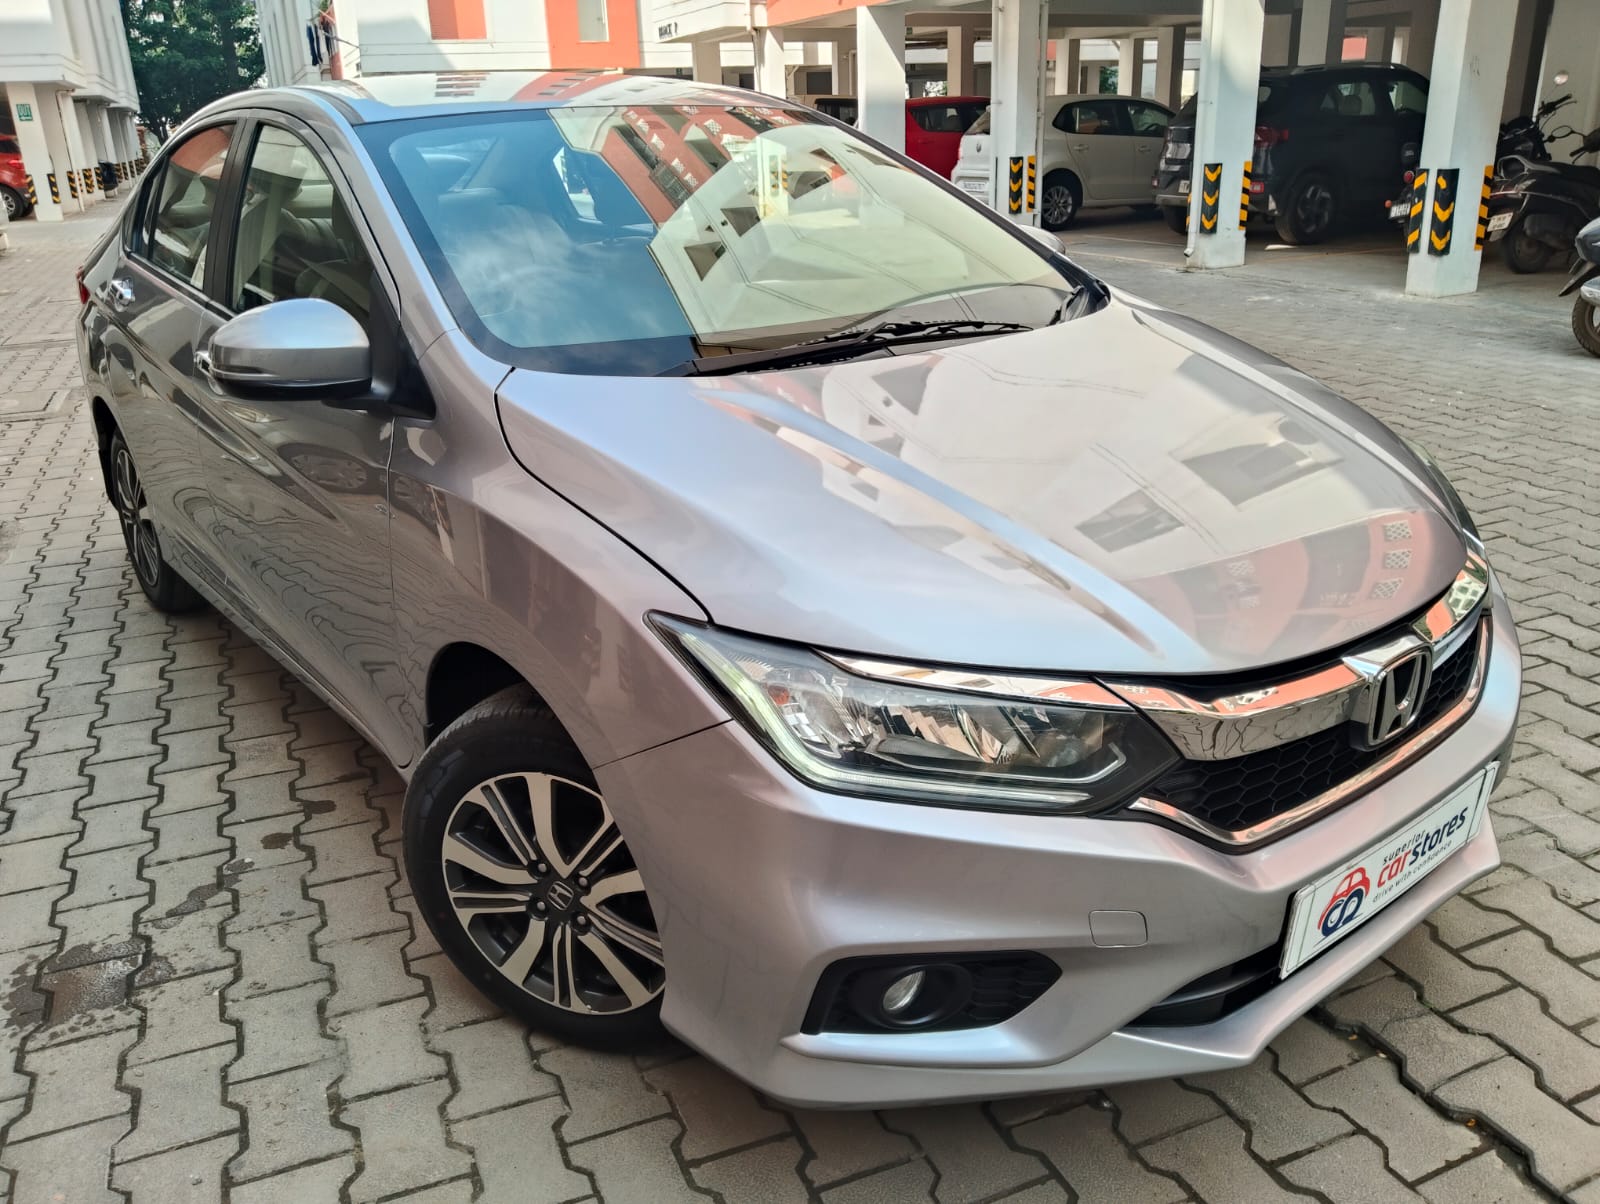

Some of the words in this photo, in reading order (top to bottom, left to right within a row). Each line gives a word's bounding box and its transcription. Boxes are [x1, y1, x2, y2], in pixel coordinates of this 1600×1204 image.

[1383, 830, 1425, 864] superior
[1372, 884, 1394, 903] drive
[1395, 871, 1412, 887] with
[1413, 840, 1452, 873] confidence
